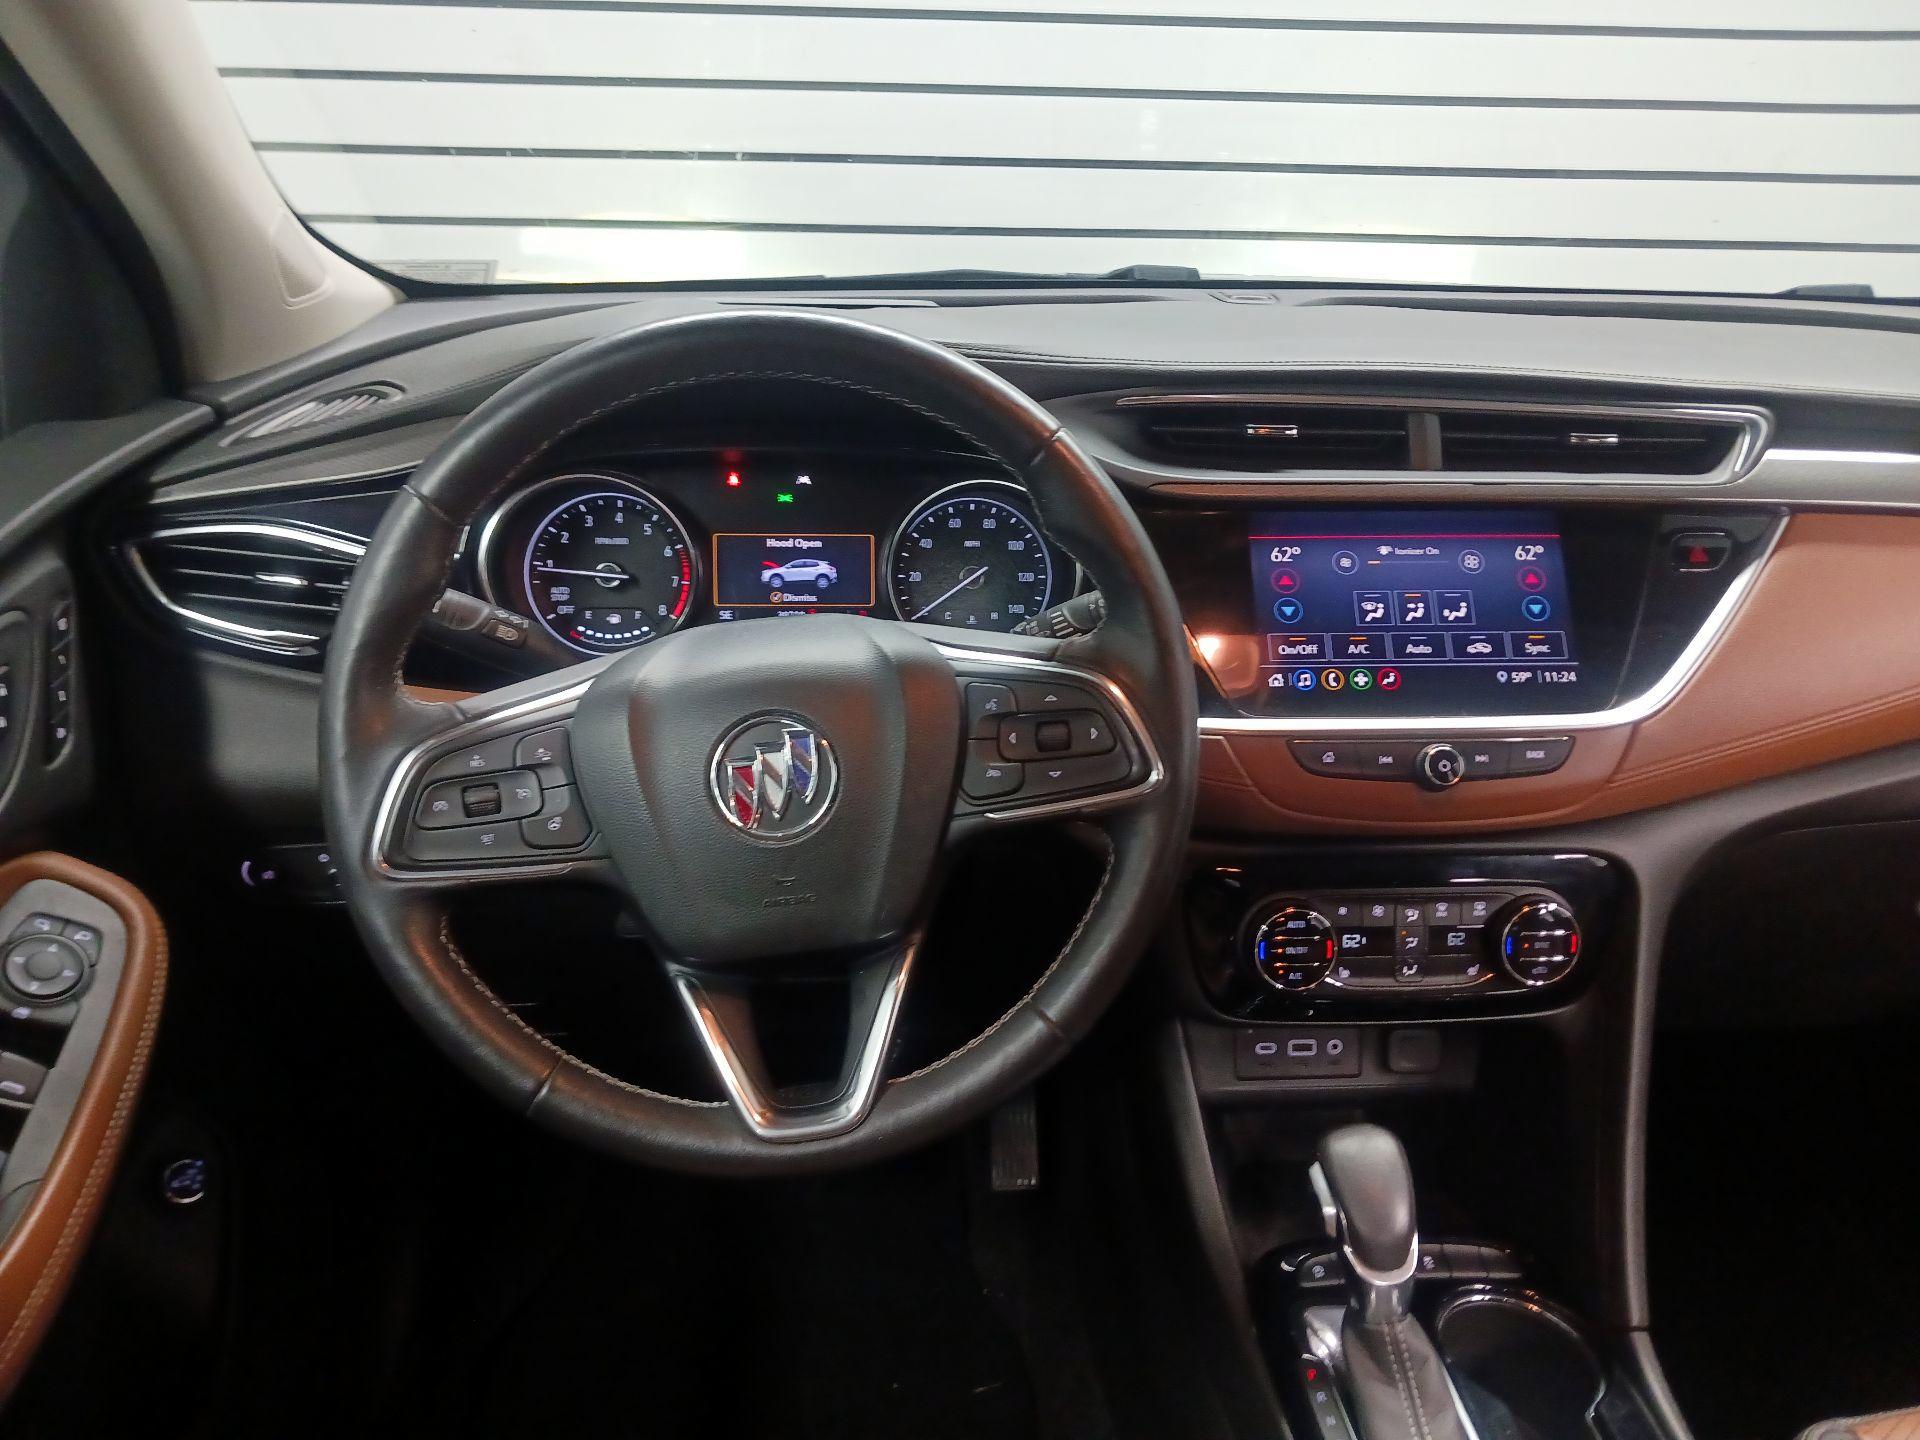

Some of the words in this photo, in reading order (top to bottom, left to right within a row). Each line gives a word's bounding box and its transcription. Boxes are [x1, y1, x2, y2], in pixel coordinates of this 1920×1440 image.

[584, 516, 594, 526] 3
[615, 512, 624, 524] 4
[644, 524, 652, 534] 5
[560, 532, 570, 544] 2
[918, 538, 932, 548] 40
[766, 538, 794, 548] Hood
[794, 538, 822, 550] Open
[1008, 540, 1024, 550] 100
[664, 546, 672, 556] 6
[1270, 546, 1301, 562] 62°
[1514, 545, 1544, 560] 62°
[546, 560, 554, 568] 1
[671, 576, 679, 586] 7
[908, 571, 922, 582] 20
[658, 604, 667, 616] 8
[1008, 604, 1024, 614] 140
[585, 610, 592, 619] E
[634, 610, 642, 619] F
[944, 612, 952, 620] C
[1278, 644, 1319, 655] On/Off
[1348, 644, 1370, 654] A/C
[1406, 644, 1432, 654] Auto
[1524, 642, 1551, 655] Sync
[1544, 671, 1577, 682] 11:24
